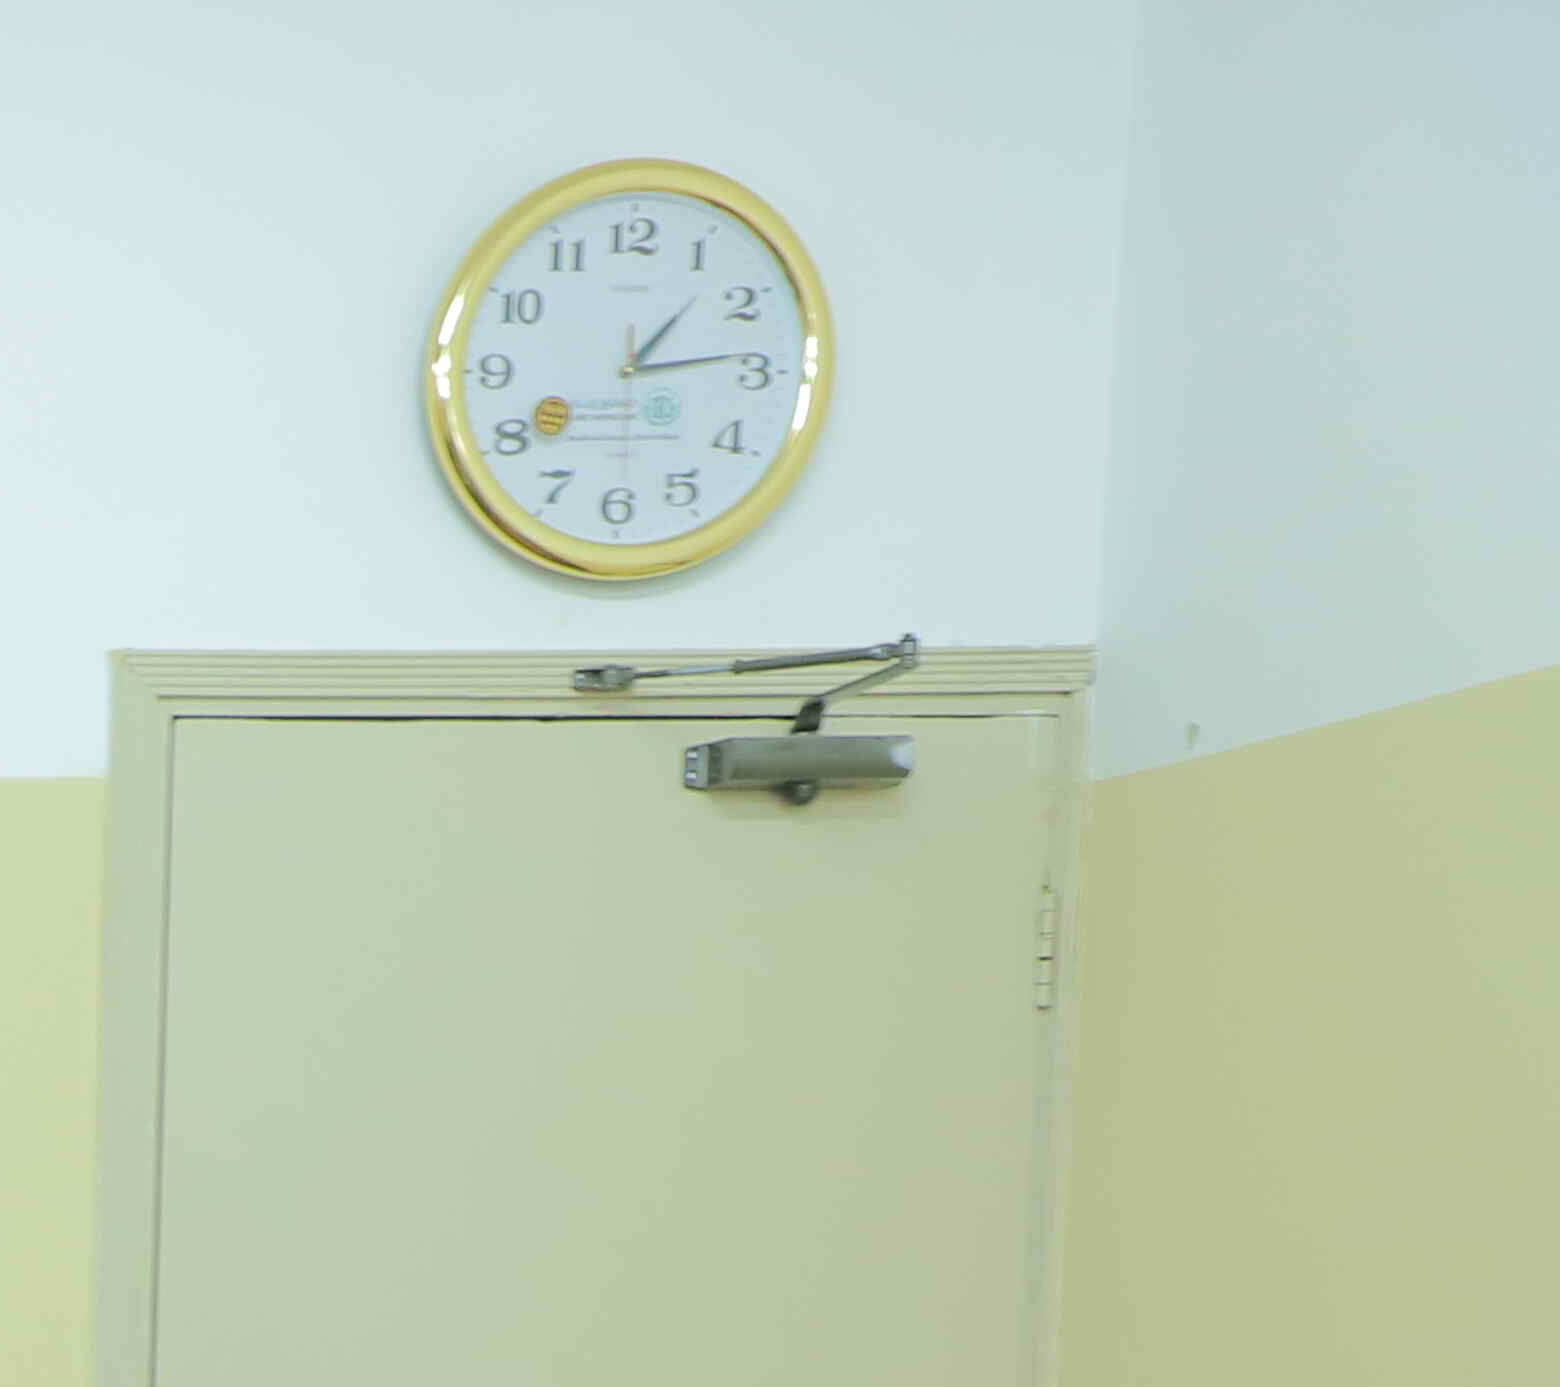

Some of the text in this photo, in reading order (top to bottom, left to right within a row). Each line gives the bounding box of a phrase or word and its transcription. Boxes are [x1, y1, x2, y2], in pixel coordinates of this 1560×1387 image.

[611, 217, 659, 256] 12
[550, 240, 585, 272] 11
[691, 239, 708, 272] 1
[500, 289, 543, 325] 10
[723, 286, 760, 322] 2
[478, 354, 514, 390] 9
[739, 352, 772, 391] 3
[493, 418, 532, 457] 8
[710, 419, 745, 456] 4
[539, 469, 574, 506] 7
[664, 467, 700, 507] 5
[599, 486, 637, 526] 6
